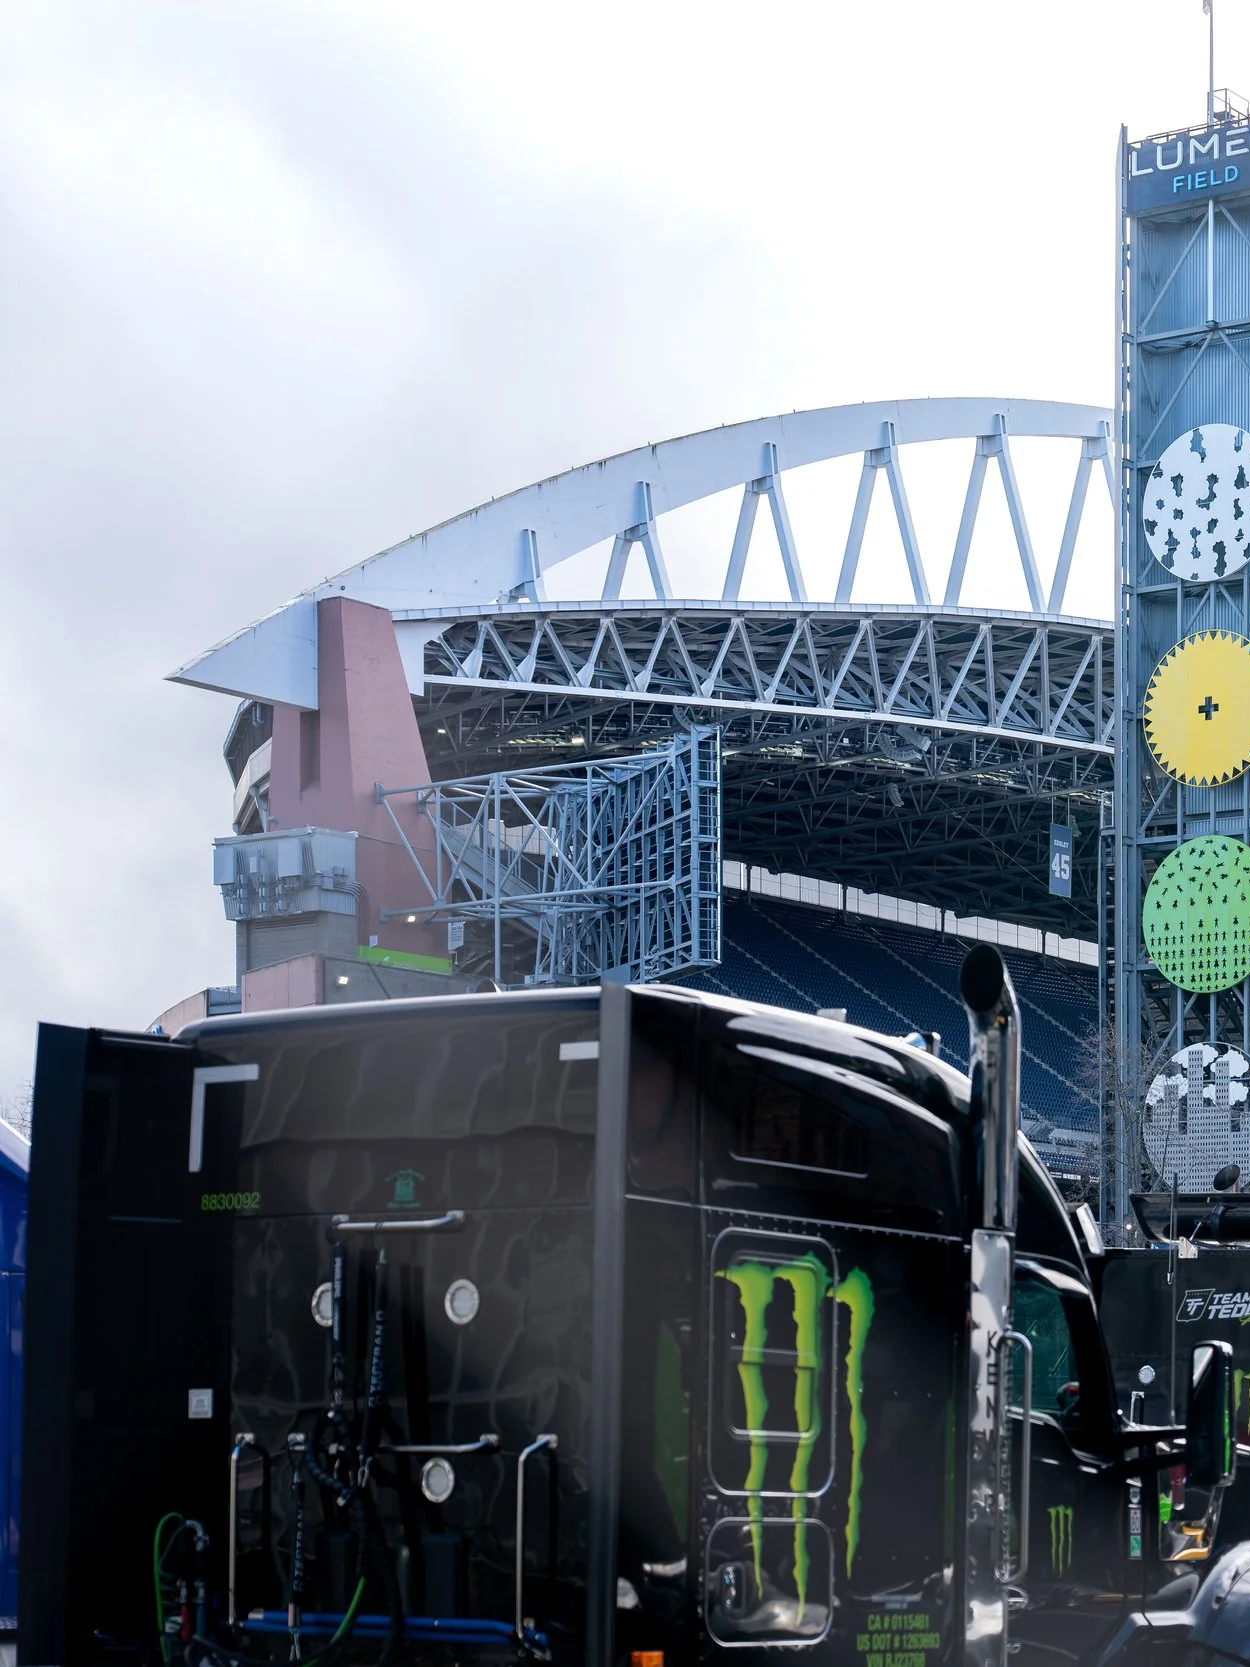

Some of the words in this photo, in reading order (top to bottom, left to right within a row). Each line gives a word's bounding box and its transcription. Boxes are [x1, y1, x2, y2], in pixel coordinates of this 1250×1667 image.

[1173, 165, 1239, 194] FIELD
[1051, 852, 1070, 880] 45
[201, 1191, 261, 1210] 8830092
[867, 1613, 882, 1631] CA
[883, 1614, 890, 1631] #
[856, 1633, 870, 1651] US
[872, 1632, 892, 1650] DOT
[893, 1633, 900, 1650] #
[866, 1653, 883, 1667] VIN
